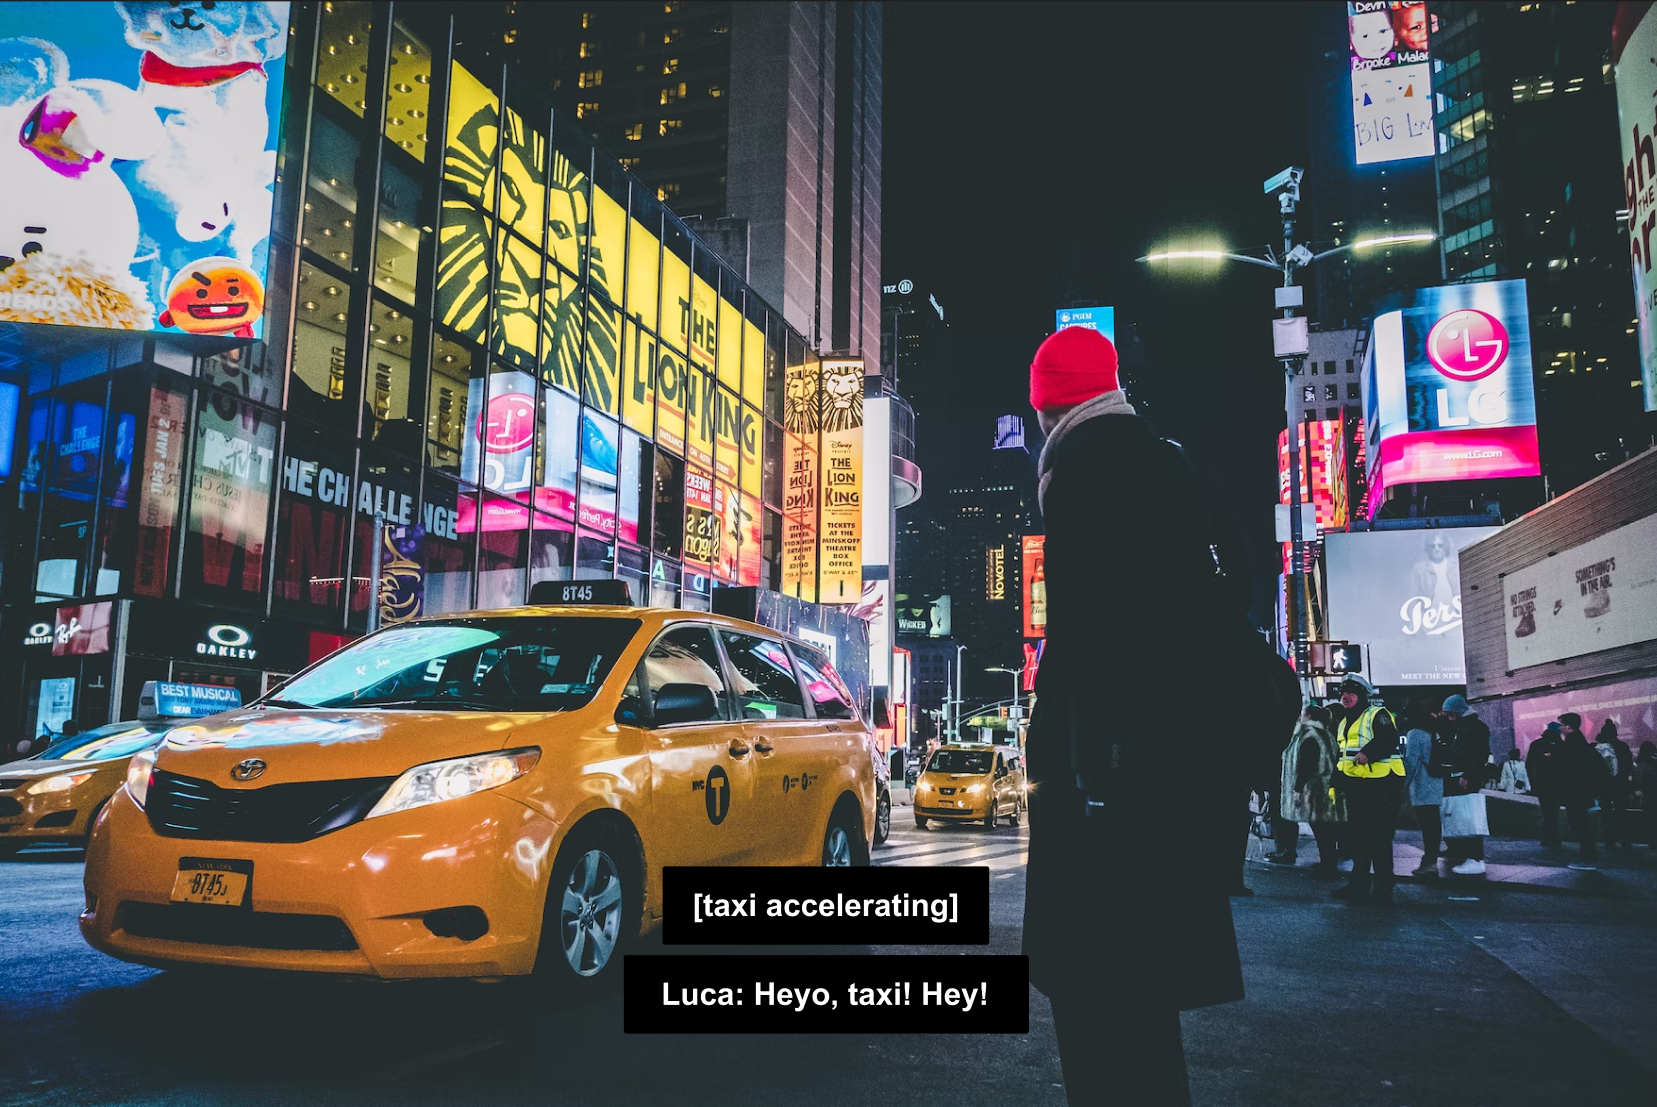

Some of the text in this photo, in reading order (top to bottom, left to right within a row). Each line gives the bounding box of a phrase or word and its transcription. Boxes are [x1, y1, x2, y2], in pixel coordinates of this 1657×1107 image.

[1355, 1, 1386, 13] Devin
[1353, 57, 1391, 71] Brooke
[1356, 117, 1394, 146] BIG
[678, 295, 715, 357] THE
[633, 311, 756, 456] LION KING
[1436, 388, 1508, 428] LG
[156, 432, 169, 459] JAN
[659, 428, 684, 450] ENTRANCE
[689, 446, 698, 457] ON
[829, 440, 852, 450] Disney
[830, 457, 851, 467] THE
[827, 469, 855, 486] LION
[257, 446, 313, 497] THE
[317, 466, 458, 541] CHALLENGE
[825, 487, 859, 507] KING
[994, 544, 1005, 600] NOVOTEL
[1575, 556, 1616, 584] SOMETHING'S
[562, 585, 593, 601] 8T45
[1517, 586, 1537, 604] STRINGS
[1580, 581, 1588, 597] IN
[24, 635, 53, 645] OAKLEY
[196, 642, 256, 660] OAKLEY
[160, 683, 238, 702] BEST MUSICAL
[173, 705, 191, 715] DEAR
[692, 780, 705, 792] NYC
[710, 777, 725, 817] T
